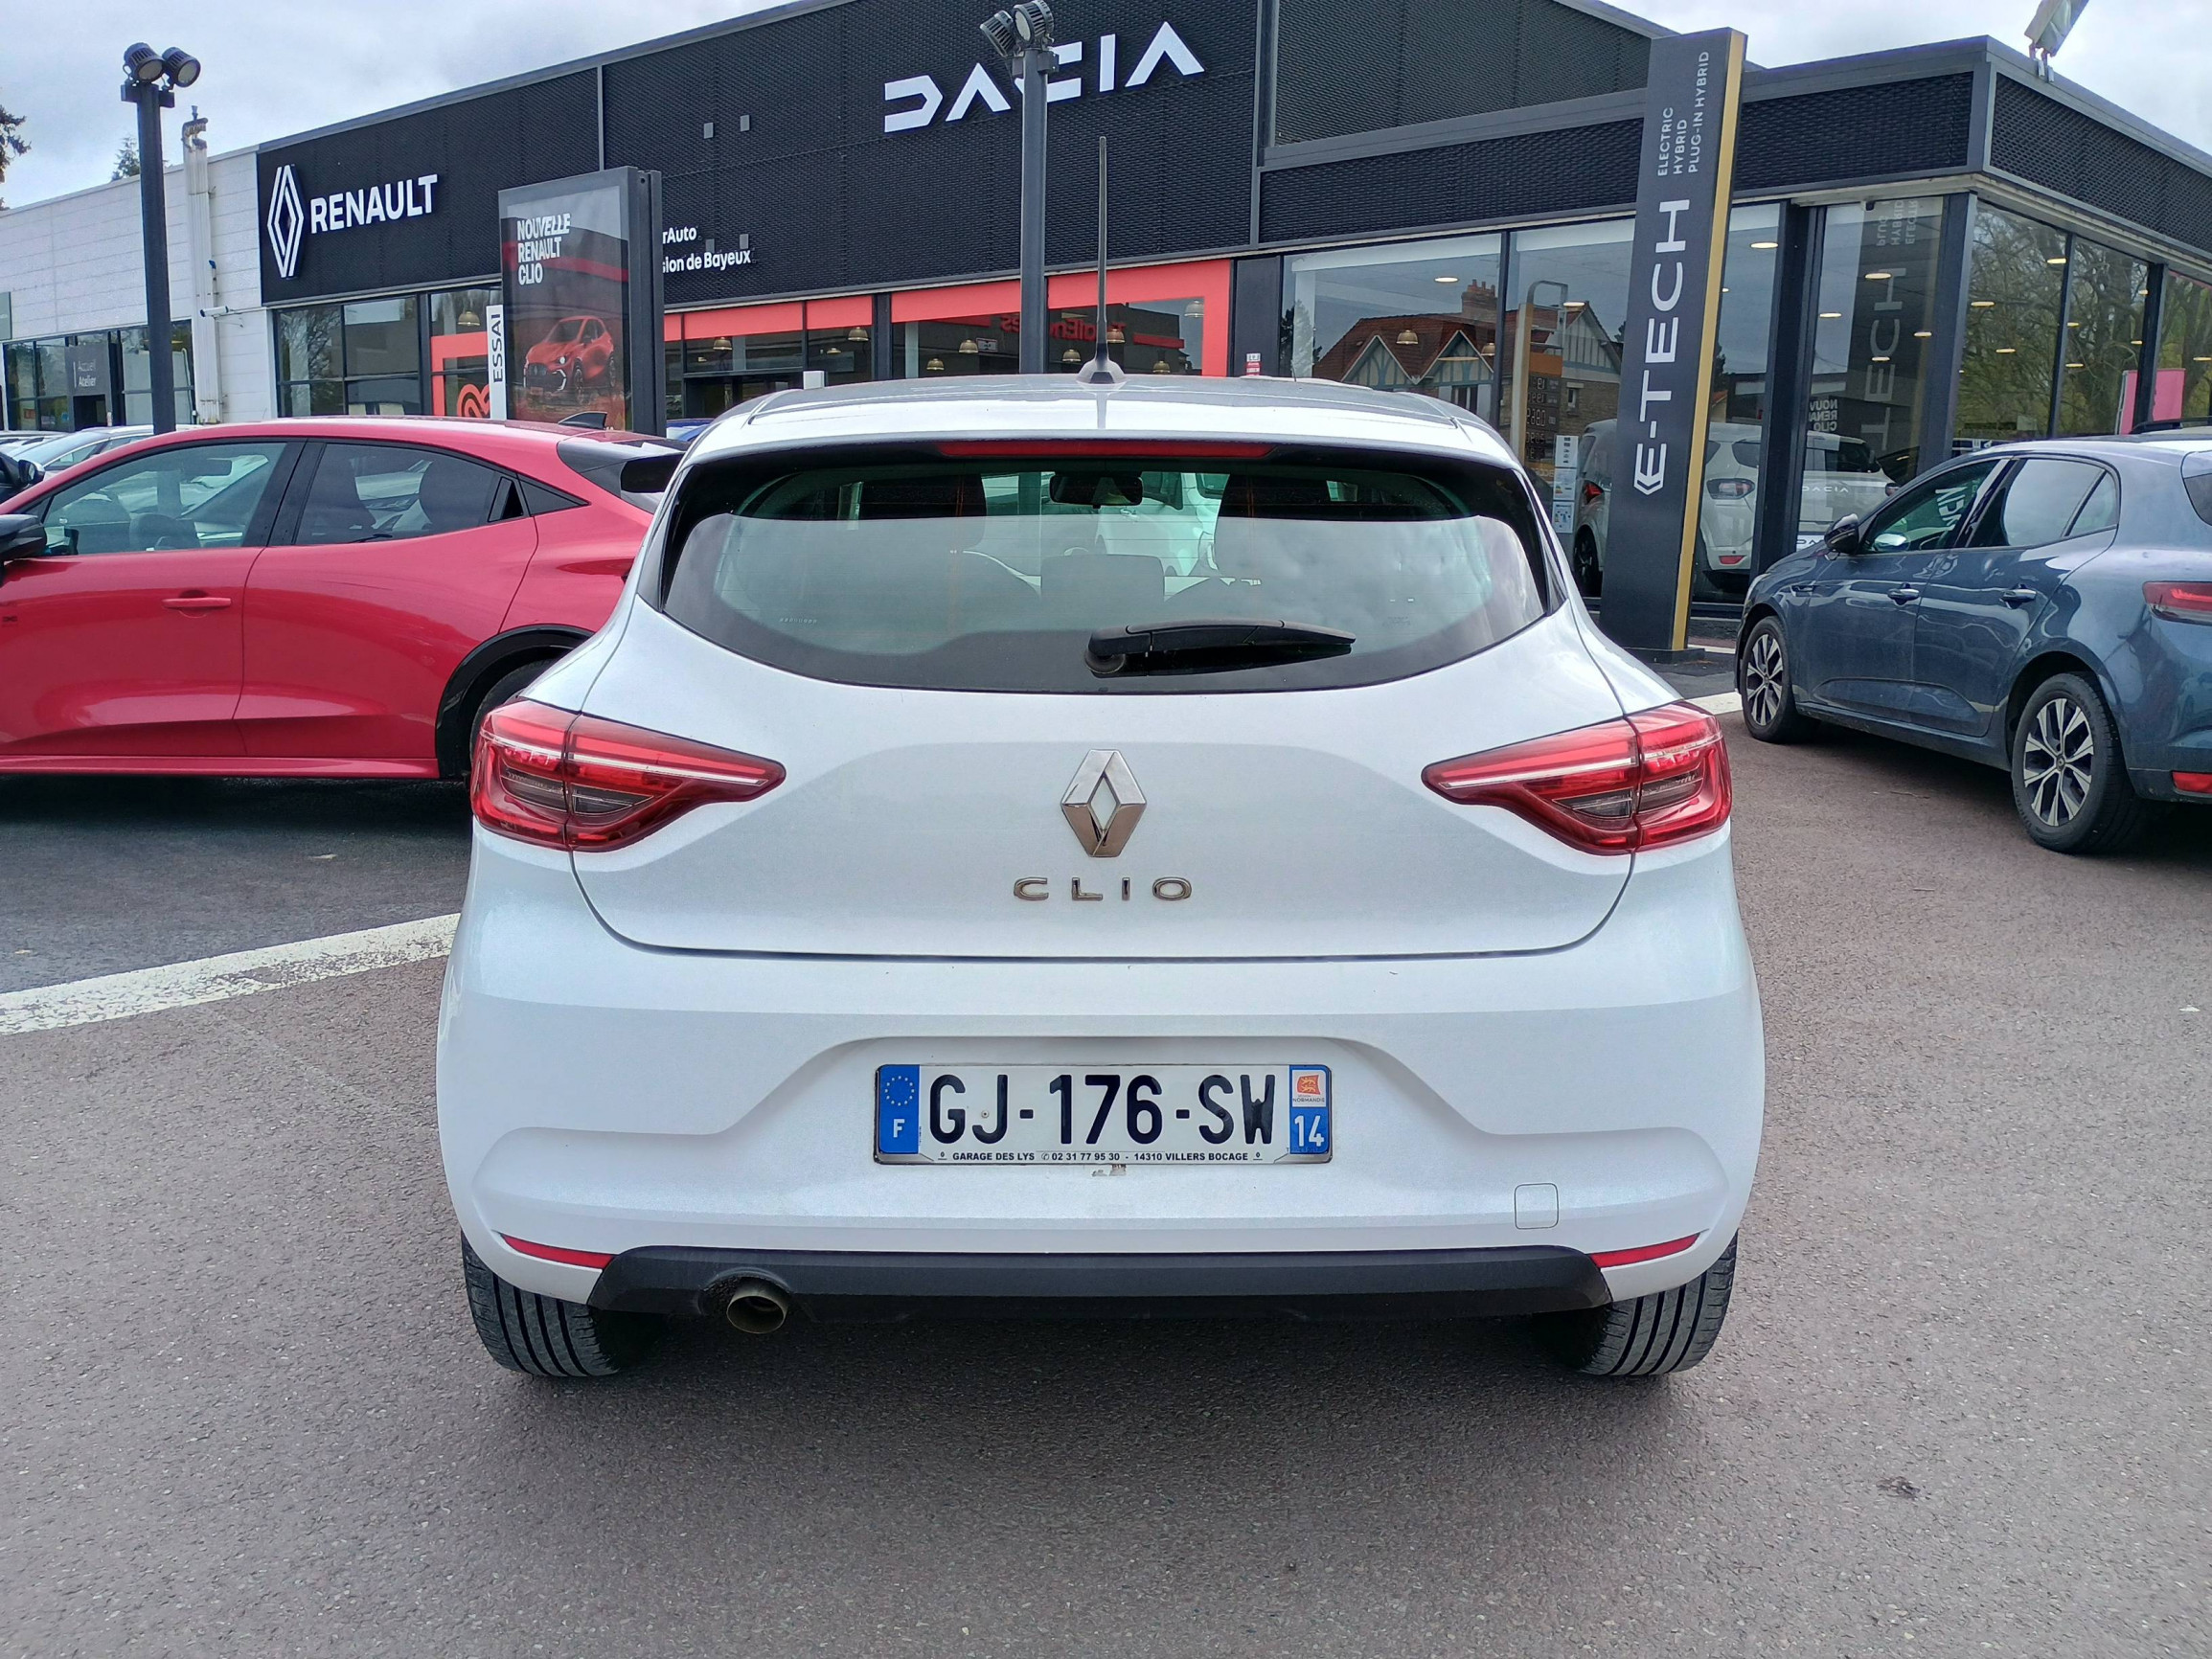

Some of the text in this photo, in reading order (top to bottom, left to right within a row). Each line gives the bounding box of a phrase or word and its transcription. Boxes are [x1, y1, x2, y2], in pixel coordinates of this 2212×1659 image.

[885, 21, 1205, 133] DACIA
[1688, 51, 1710, 173] PLUG-IN HYBRID
[1657, 106, 1674, 176] ELECTRIC
[1673, 119, 1687, 174] HYBRID
[310, 173, 438, 234] RENAULT
[517, 213, 571, 241] NOUVELLE
[517, 237, 561, 263] RENAULT
[686, 252, 702, 271] de
[703, 250, 751, 271] Bayeux
[518, 262, 543, 286] CLIO
[490, 313, 503, 383] ESSAI
[1633, 199, 1690, 496] E-TECH
[1014, 876, 1192, 901] CLIO
[893, 1118, 905, 1138] F
[929, 1074, 1276, 1145] GJ-176-SW
[1294, 1115, 1325, 1148] 14
[952, 1152, 993, 1161] GARAGE
[995, 1152, 1015, 1161] DES
[1017, 1152, 1035, 1161] LYS
[1051, 1152, 1063, 1161] 02
[1065, 1152, 1077, 1161] 31
[1080, 1152, 1091, 1161] 77
[1094, 1152, 1106, 1161] 95
[1108, 1152, 1120, 1161] 30
[1134, 1152, 1162, 1161] 14310
[1165, 1152, 1205, 1161] VILLERS
[1208, 1152, 1248, 1161] BOCAGE
